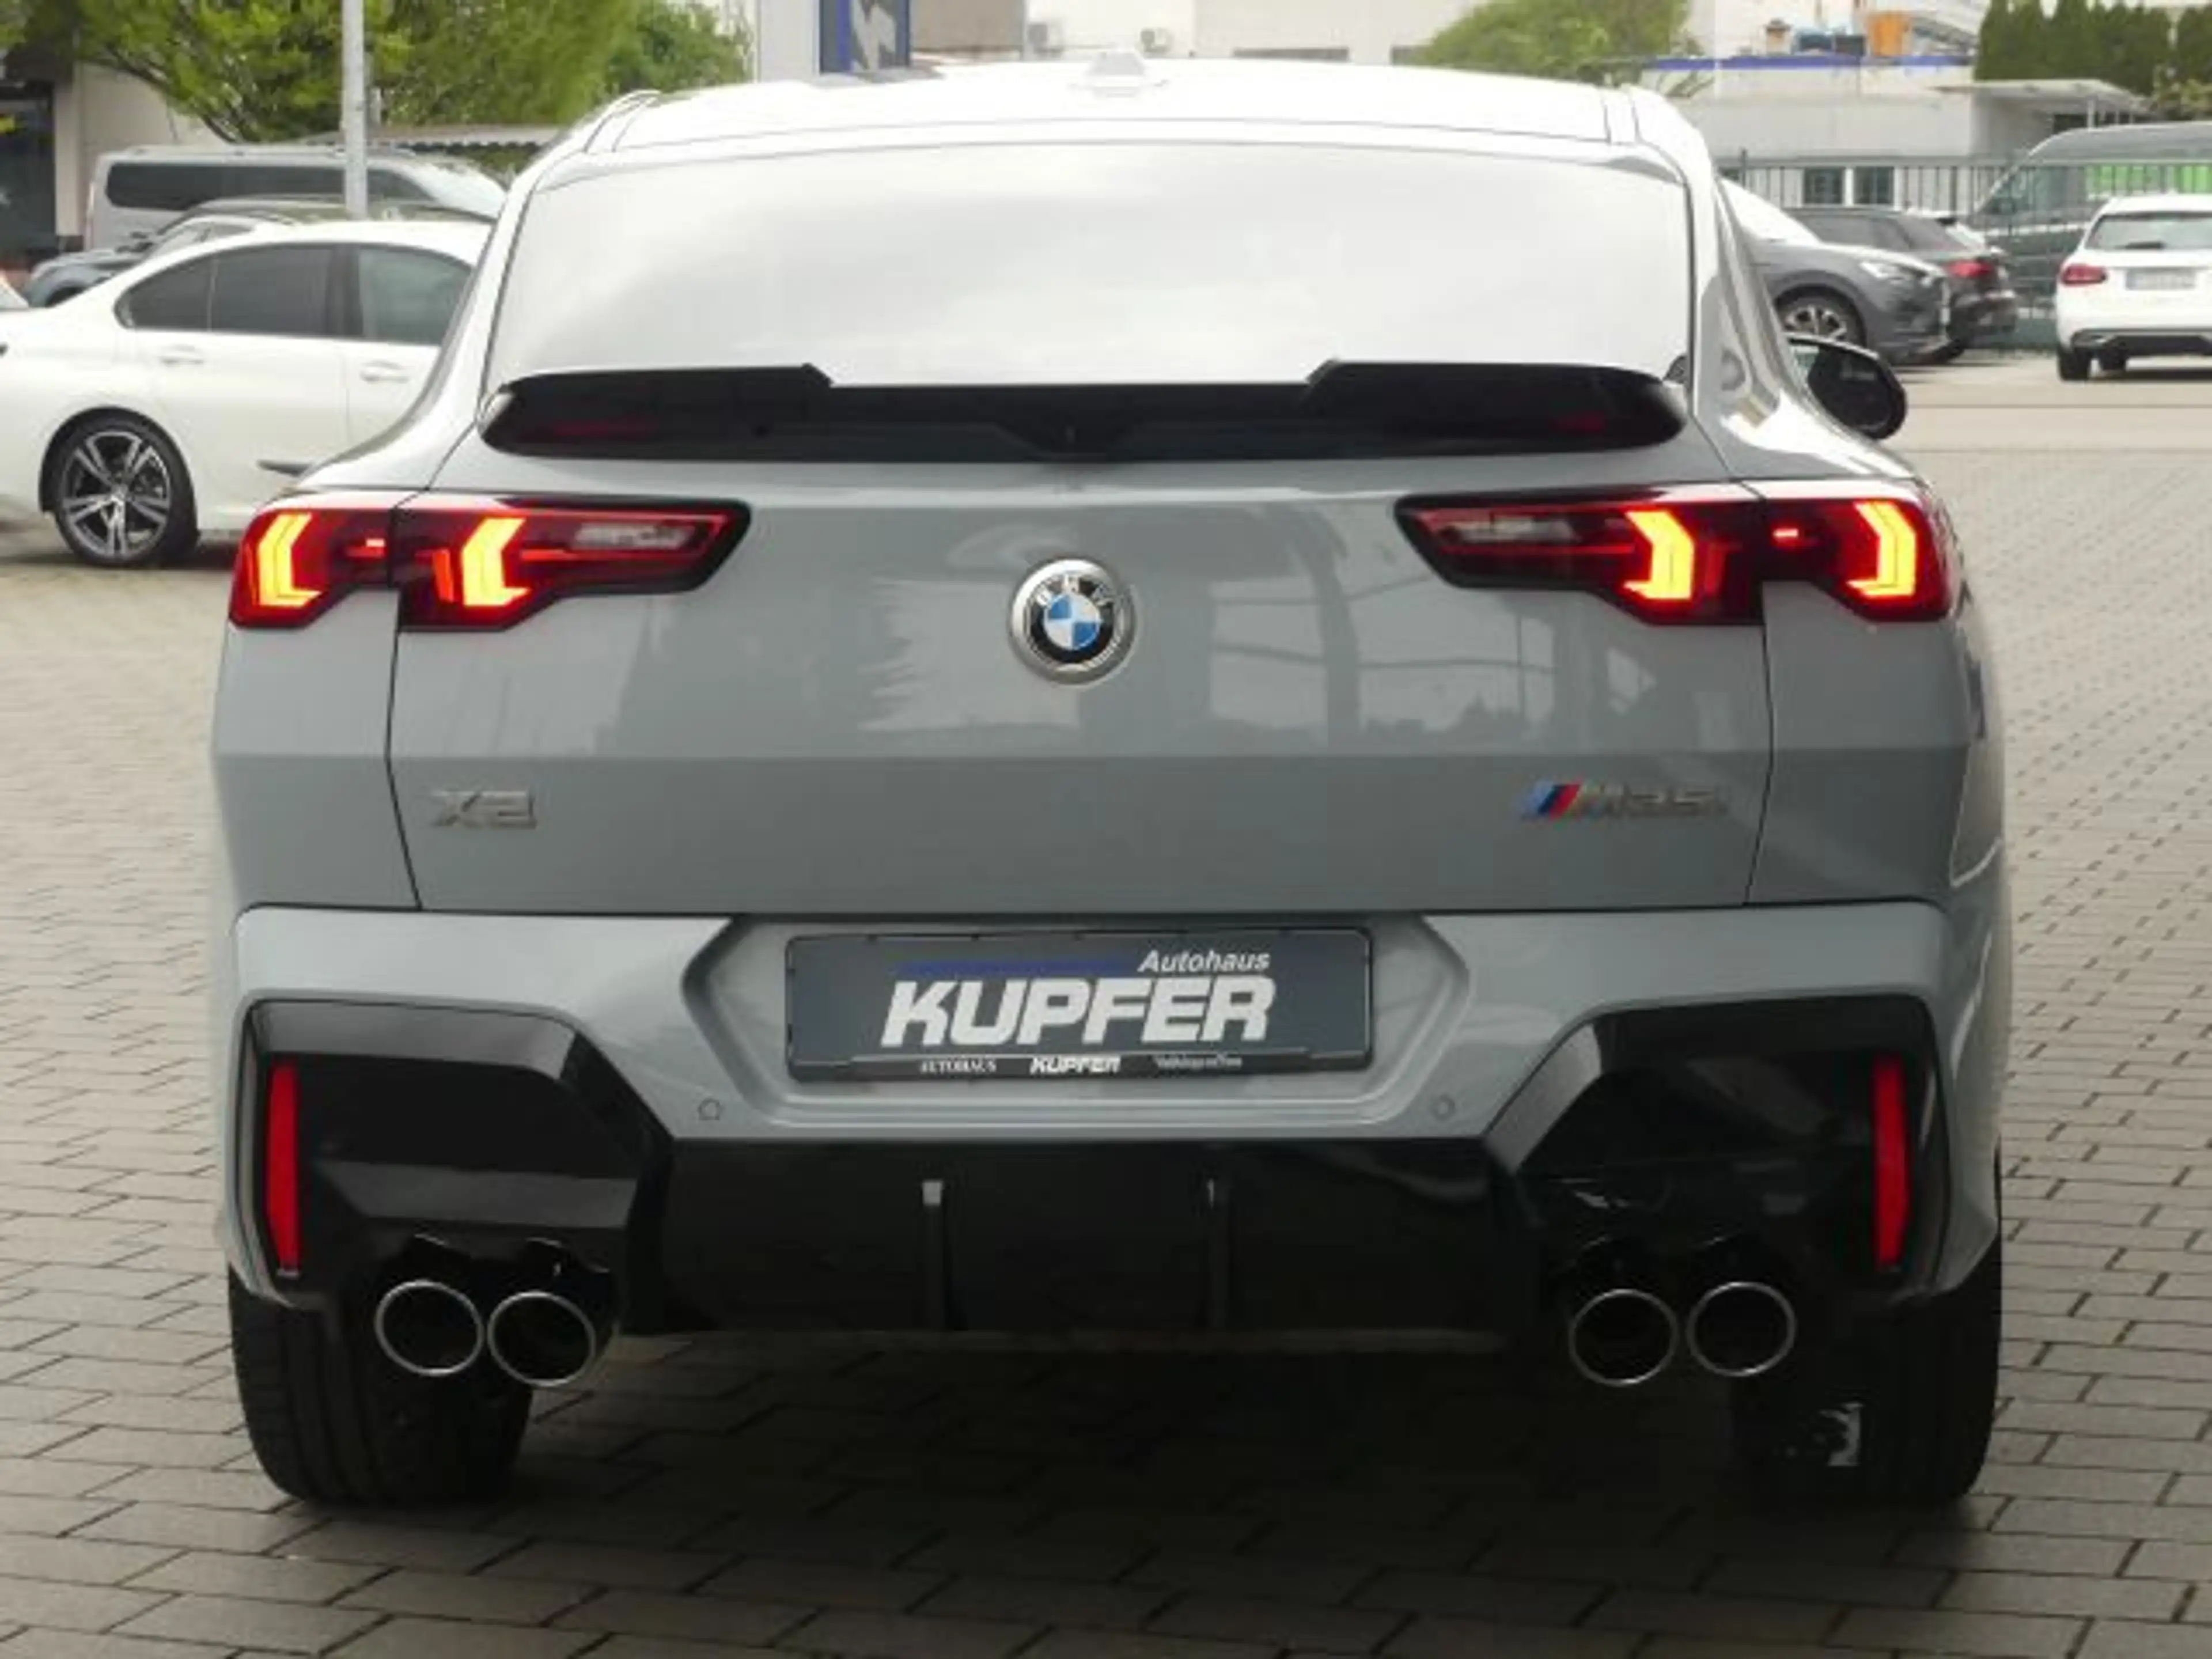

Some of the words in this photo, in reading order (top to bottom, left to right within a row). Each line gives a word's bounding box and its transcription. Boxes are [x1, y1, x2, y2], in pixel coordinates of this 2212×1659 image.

[431, 790, 537, 830] X2
[1137, 950, 1271, 973] Autohaus
[880, 975, 1277, 1047] KUPFER
[1029, 1055, 1121, 1074] KUPFER
